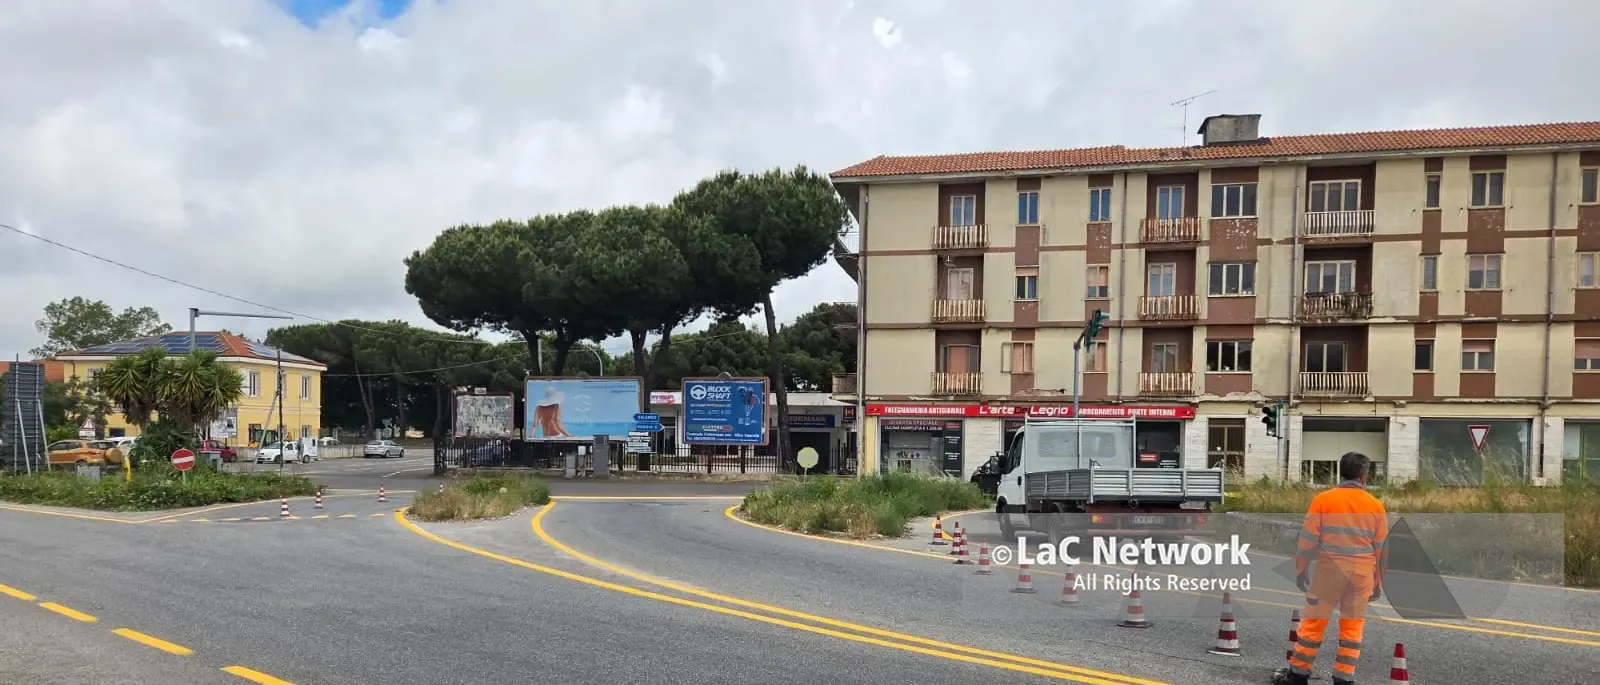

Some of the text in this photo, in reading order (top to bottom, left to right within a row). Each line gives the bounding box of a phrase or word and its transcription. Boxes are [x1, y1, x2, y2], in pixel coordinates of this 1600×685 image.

[884, 406, 928, 414] FALEGNAMERIA
[980, 406, 1015, 414] L'arte
[1030, 406, 1068, 416] Legno
[1078, 408, 1125, 416] ARREDAMENTO
[1128, 408, 1148, 416] PORTE
